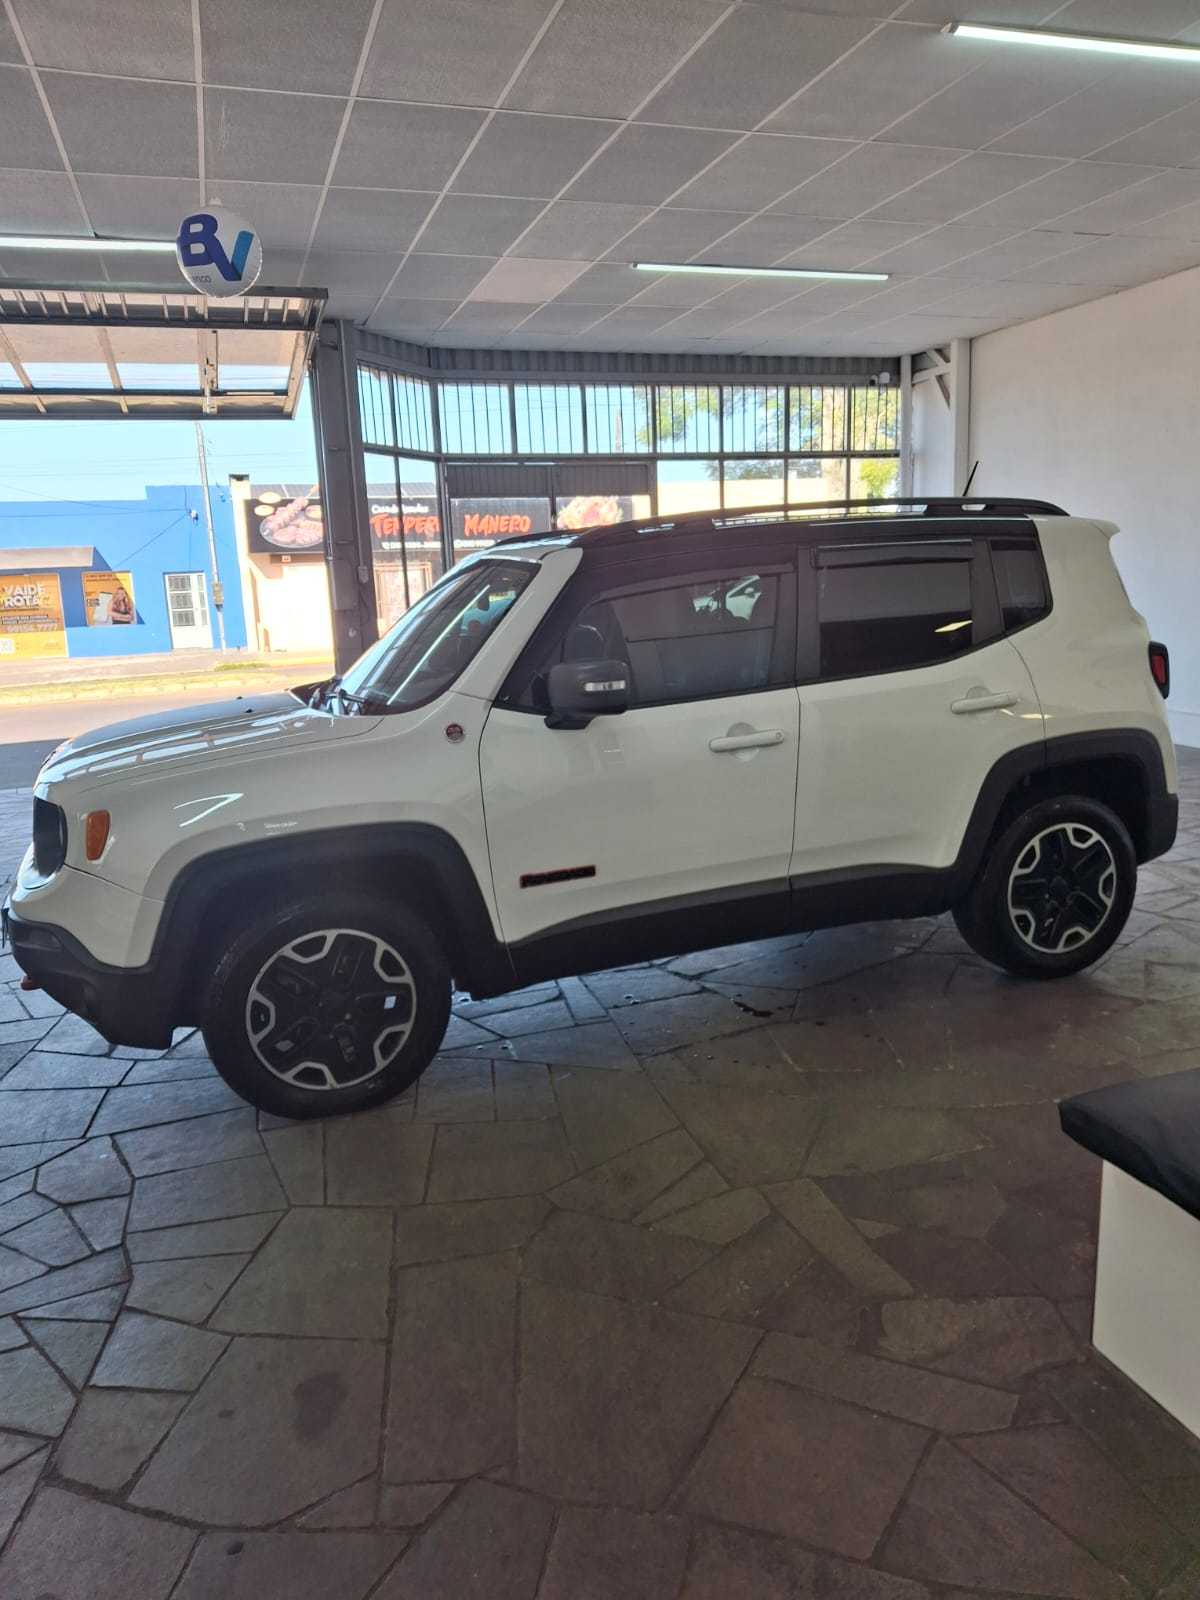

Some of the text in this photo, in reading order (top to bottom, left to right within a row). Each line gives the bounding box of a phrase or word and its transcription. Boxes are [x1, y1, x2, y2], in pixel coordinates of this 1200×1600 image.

[176, 213, 254, 281] BV
[369, 512, 531, 538] TEMPER MANERO
